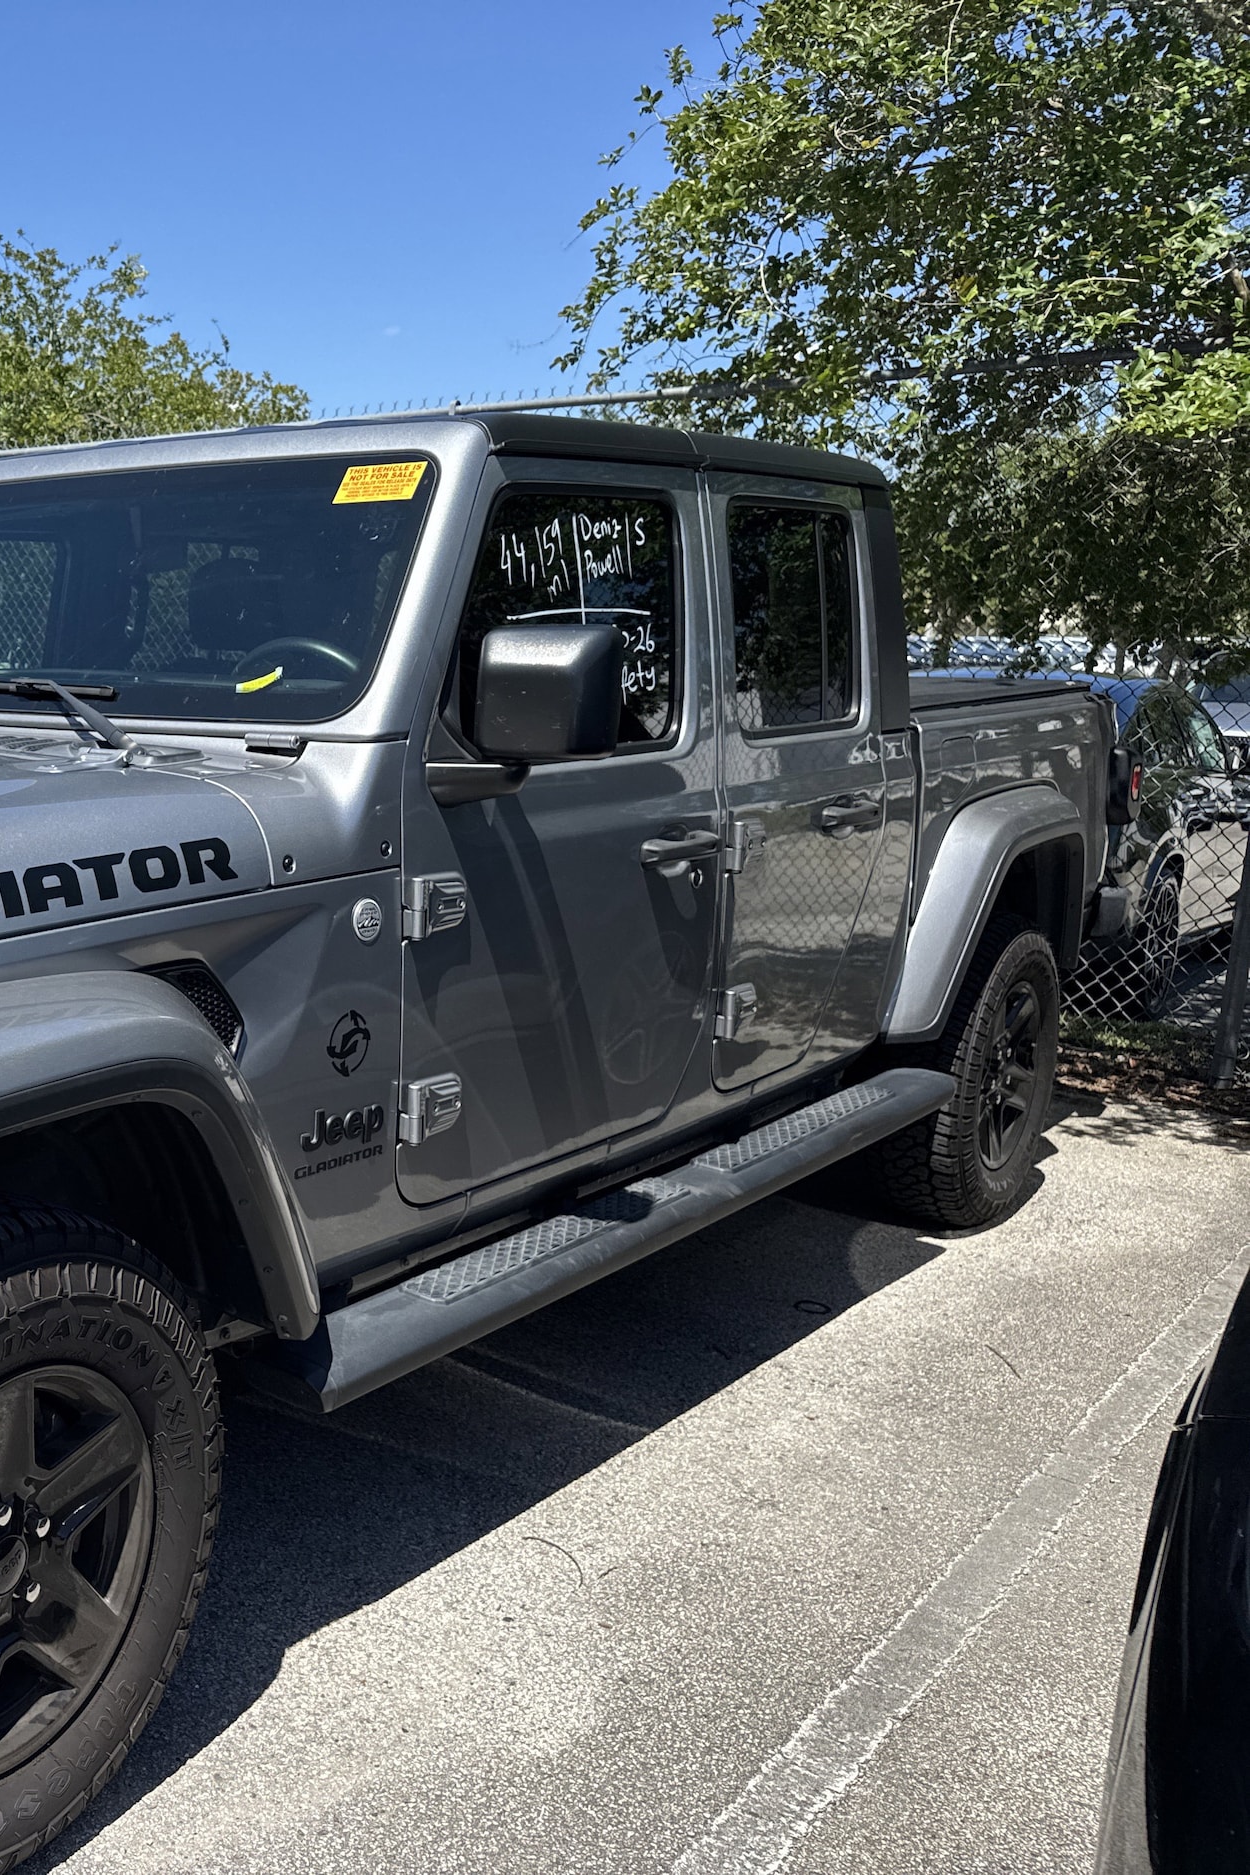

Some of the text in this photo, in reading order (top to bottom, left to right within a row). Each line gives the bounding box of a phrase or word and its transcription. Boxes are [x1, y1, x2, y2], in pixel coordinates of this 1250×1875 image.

[349, 463, 422, 475] THIS VEHICLE IS
[349, 474, 369, 482] NOT
[391, 470, 416, 478] SALE
[583, 543, 625, 583] Powell
[300, 1103, 384, 1152] Jeep
[293, 1144, 384, 1180] GLADIATOR
